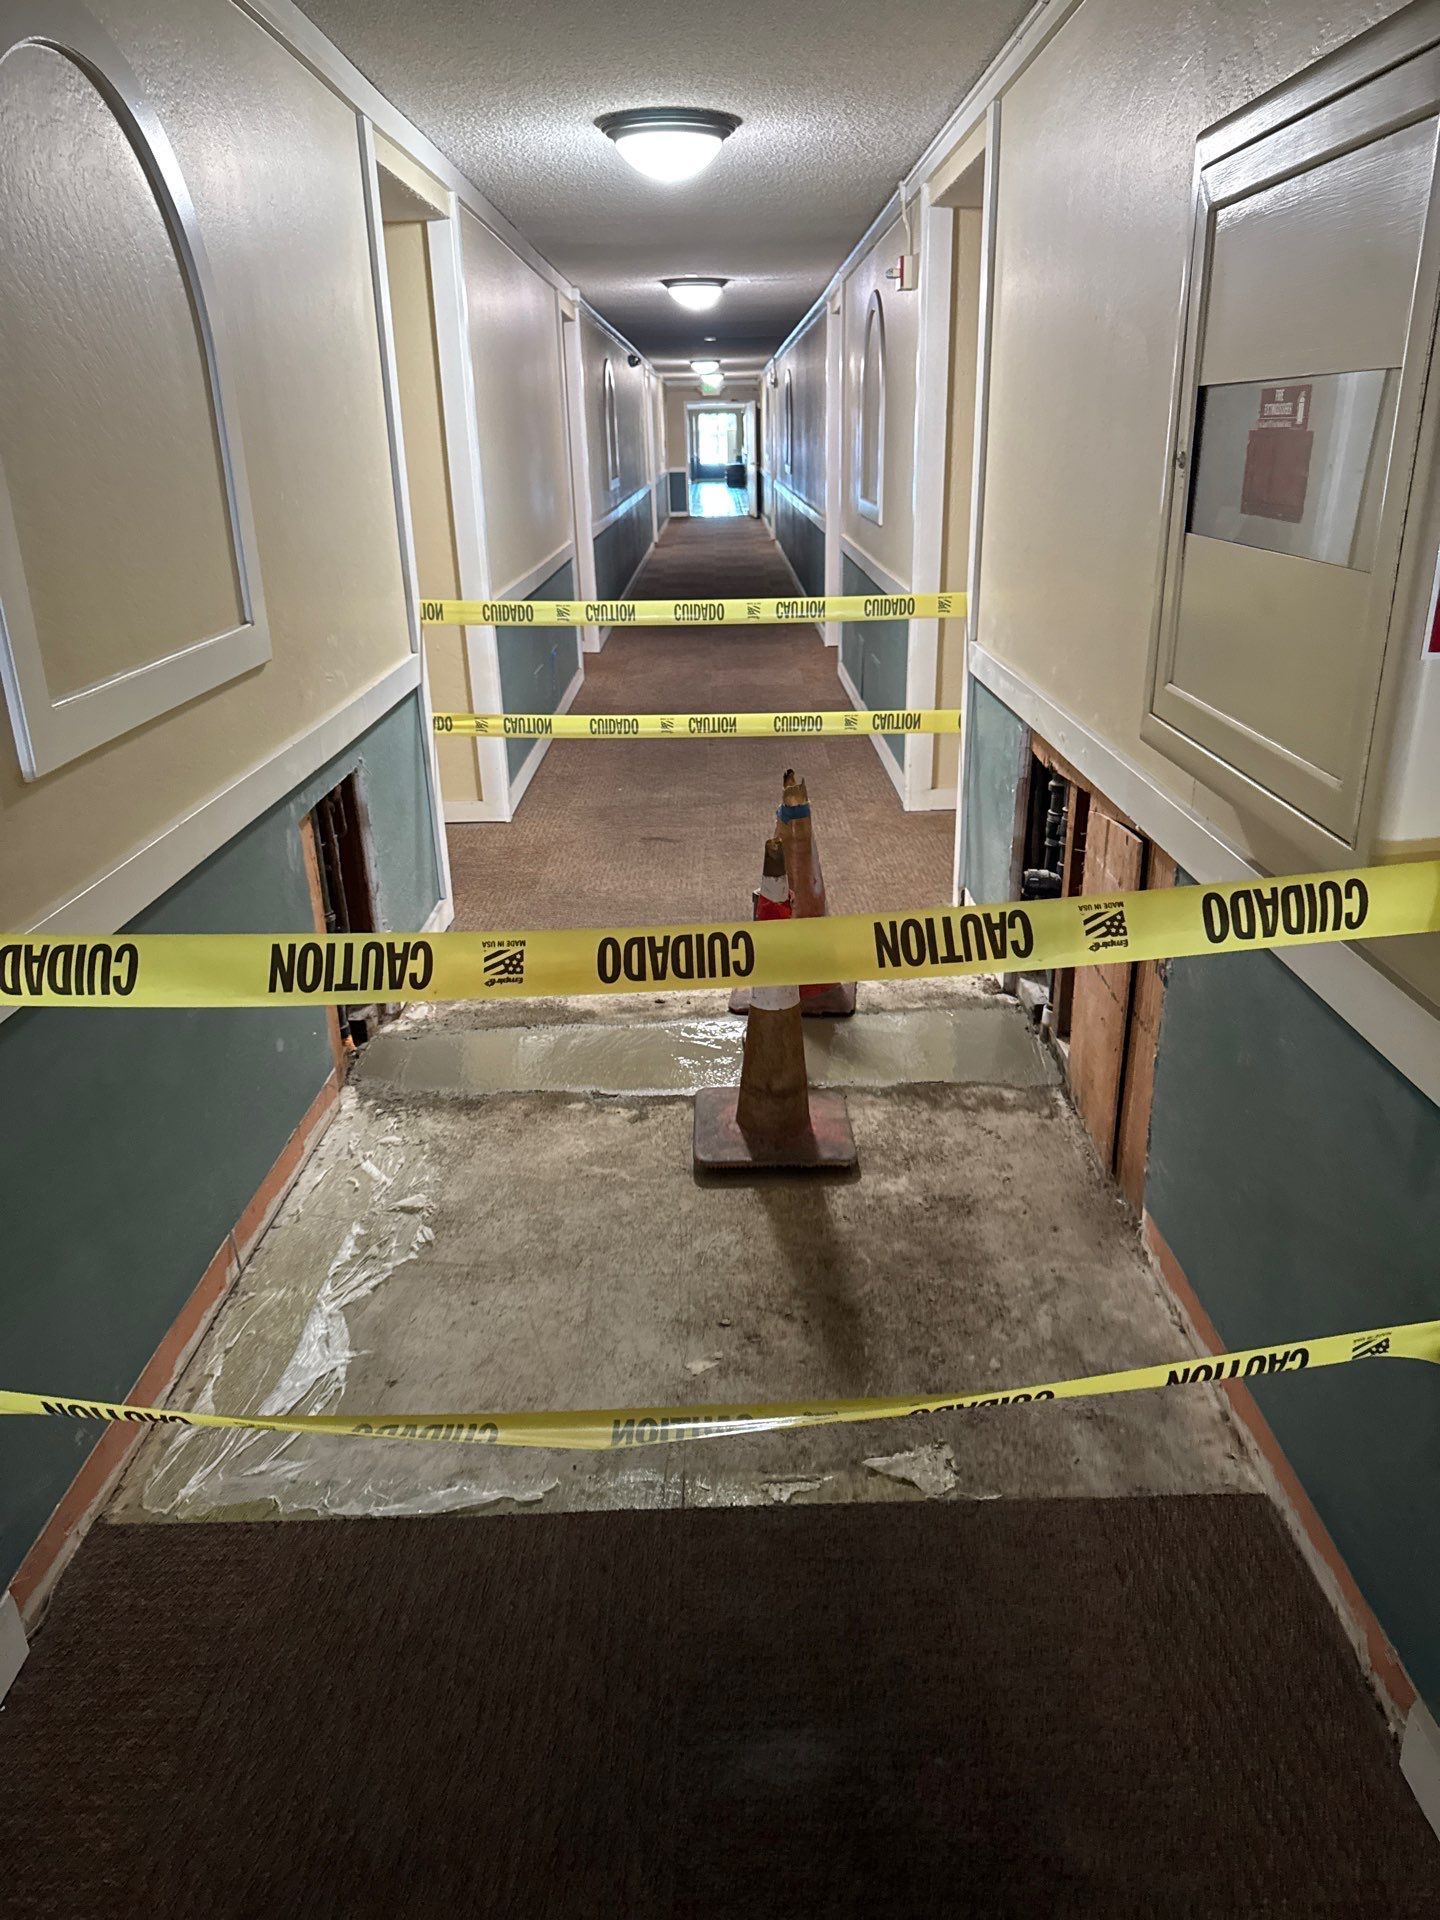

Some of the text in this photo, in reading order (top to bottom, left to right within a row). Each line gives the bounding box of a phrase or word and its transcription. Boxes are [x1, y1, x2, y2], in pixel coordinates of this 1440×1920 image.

[1202, 877, 1369, 945] CUIDADO
[481, 940, 526, 948] MADE IN USA
[596, 930, 755, 984] CUIDADO
[873, 909, 1034, 969] CAUTION
[268, 940, 434, 994] CAUTION
